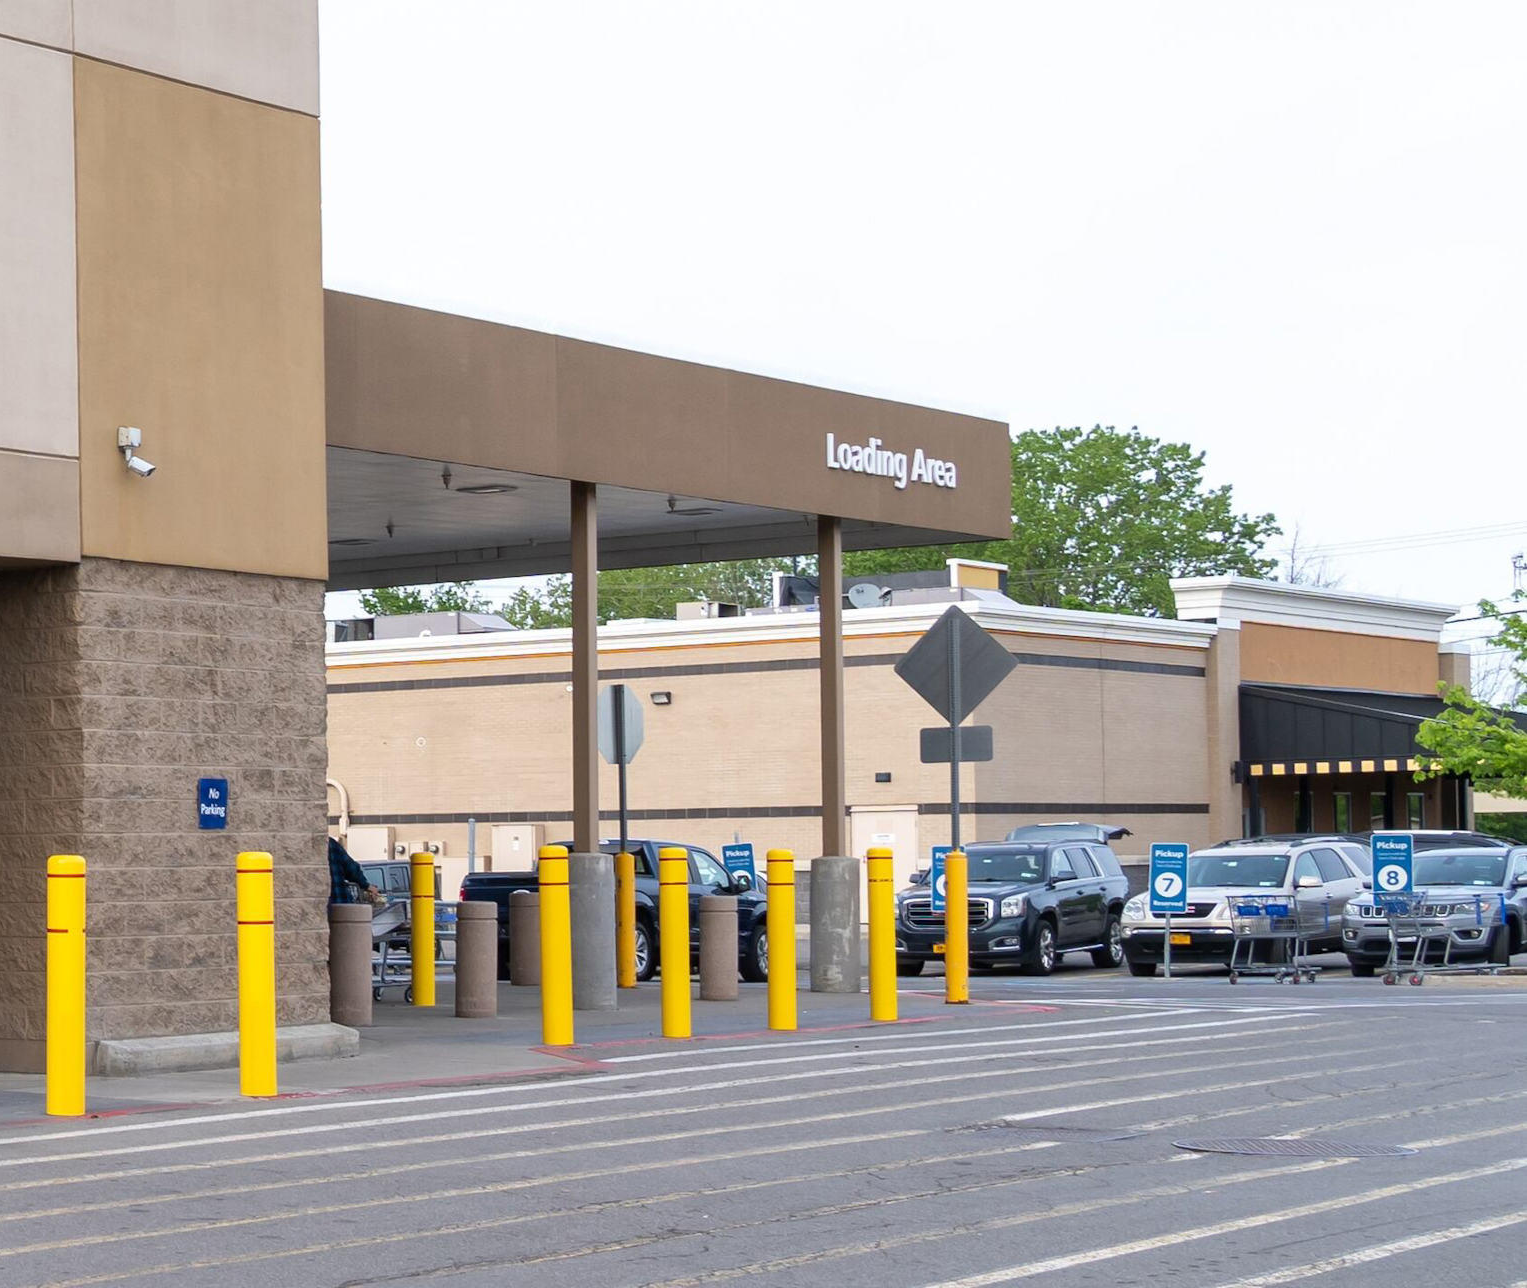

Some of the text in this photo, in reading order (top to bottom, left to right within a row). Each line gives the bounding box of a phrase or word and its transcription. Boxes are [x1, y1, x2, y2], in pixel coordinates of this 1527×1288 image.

[826, 432, 956, 489] Loading Area
[208, 788, 220, 799] No
[200, 803, 226, 818] Parking
[1376, 841, 1408, 850] Pickup
[1155, 849, 1184, 858] Pickup
[1162, 878, 1174, 892] 7
[1387, 871, 1399, 885] 8
